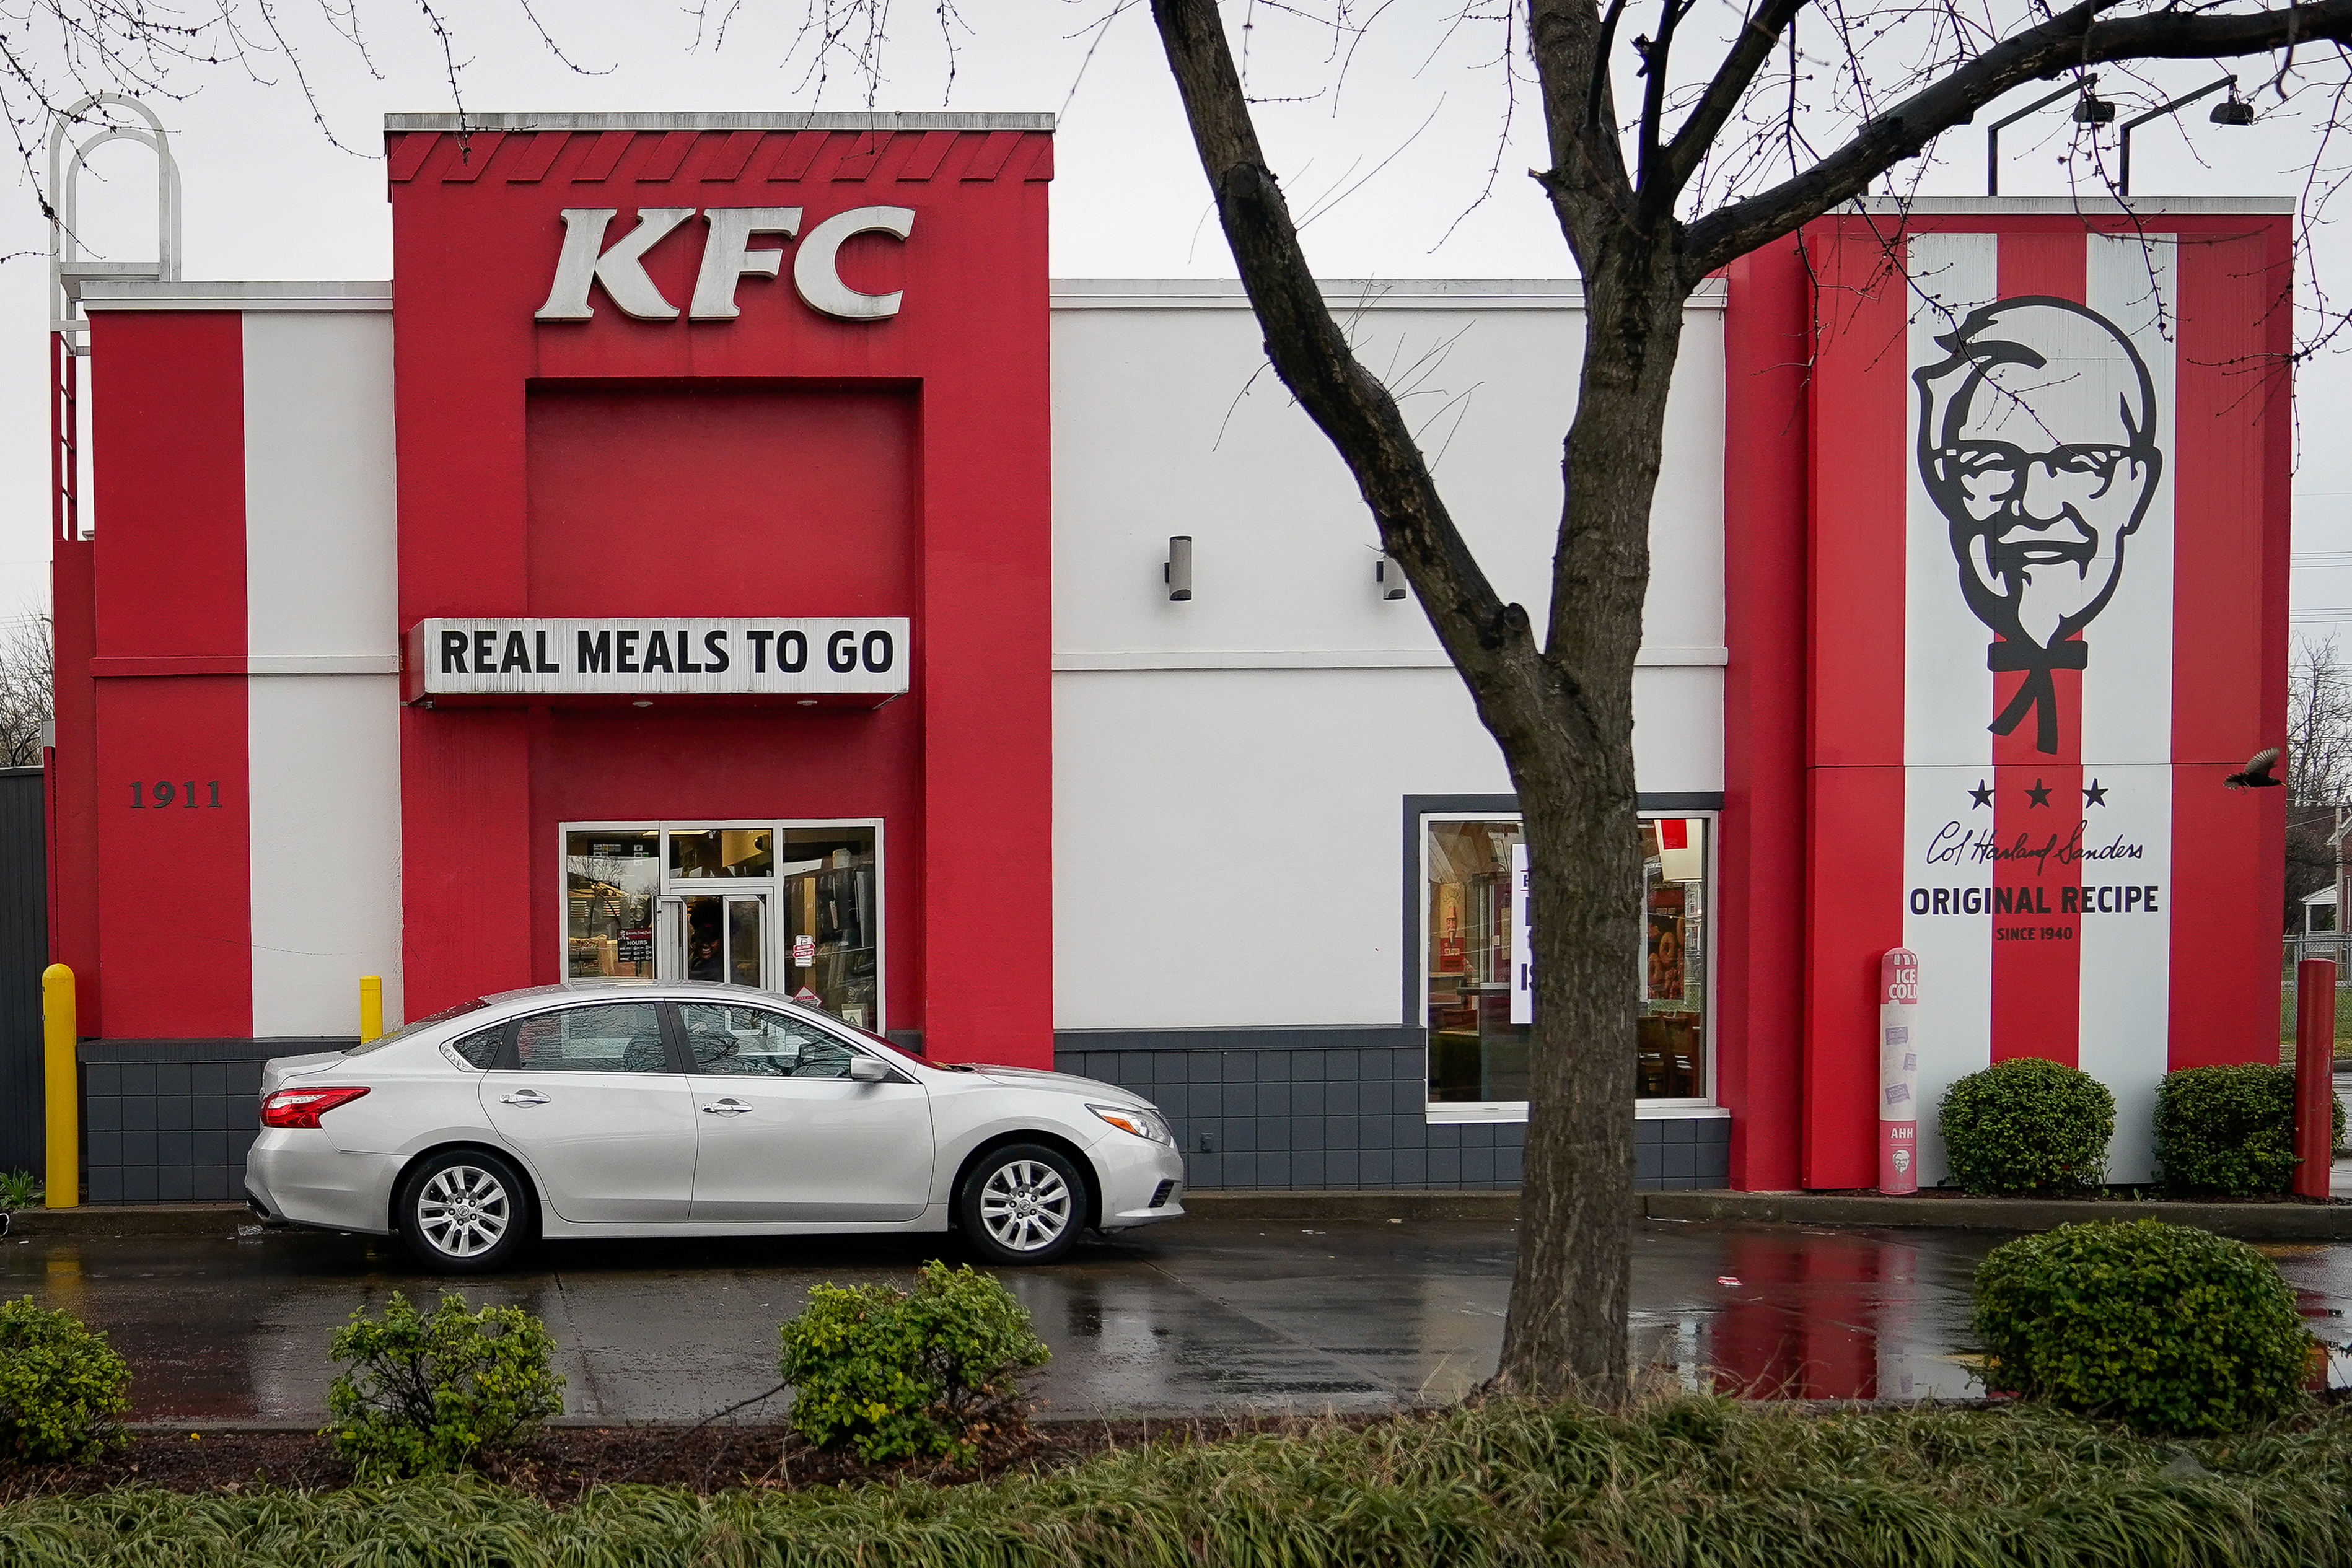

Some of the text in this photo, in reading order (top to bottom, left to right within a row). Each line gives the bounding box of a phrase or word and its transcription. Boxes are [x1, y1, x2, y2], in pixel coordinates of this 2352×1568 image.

[535, 206, 915, 322] KFC
[441, 630, 893, 674] REAL MEALS TO GO
[129, 781, 222, 808] 1911
[1926, 821, 1973, 865] Col
[2053, 820, 2144, 865] Sanders
[1910, 885, 2159, 915] ORIGINAL RECIPE
[1996, 927, 2073, 940] SINCE 1940
[1896, 968, 1916, 984] ICE
[1889, 984, 1918, 999] COLD
[1891, 1128, 1913, 1139] AHH
